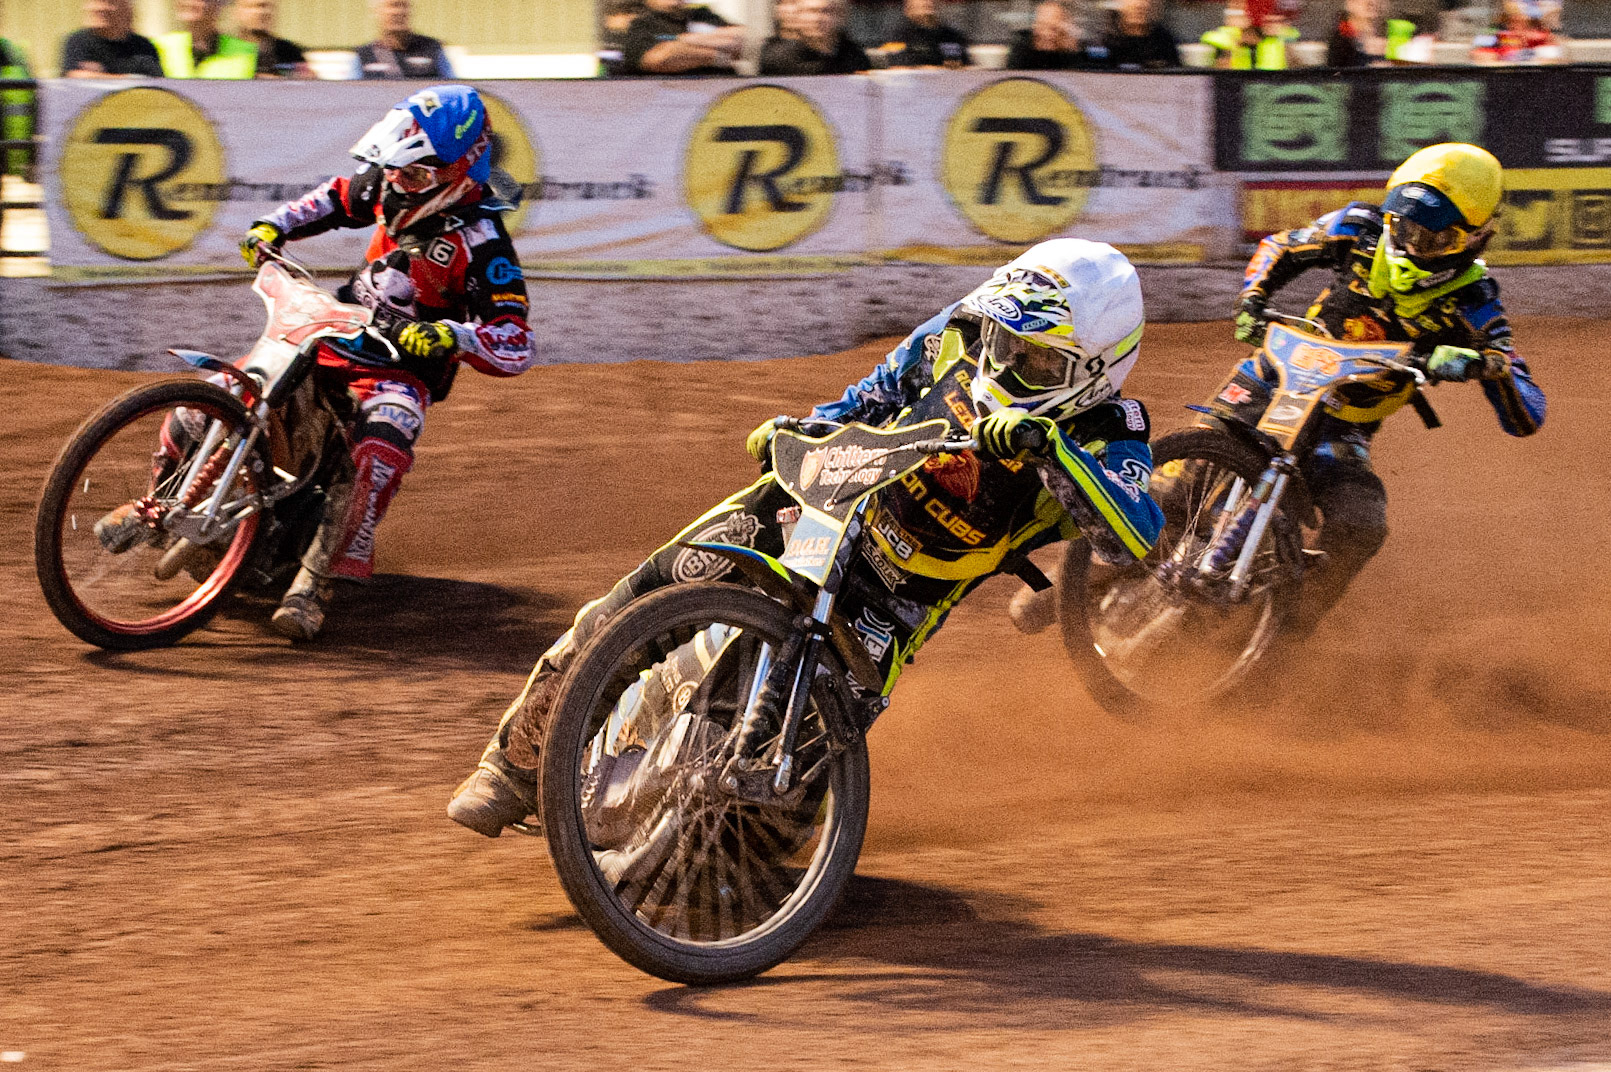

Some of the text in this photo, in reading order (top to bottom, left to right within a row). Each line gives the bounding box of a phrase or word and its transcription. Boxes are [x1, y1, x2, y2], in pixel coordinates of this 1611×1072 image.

[433, 244, 450, 263] 6
[925, 498, 987, 546] CUBS
[878, 523, 913, 560] JCB
